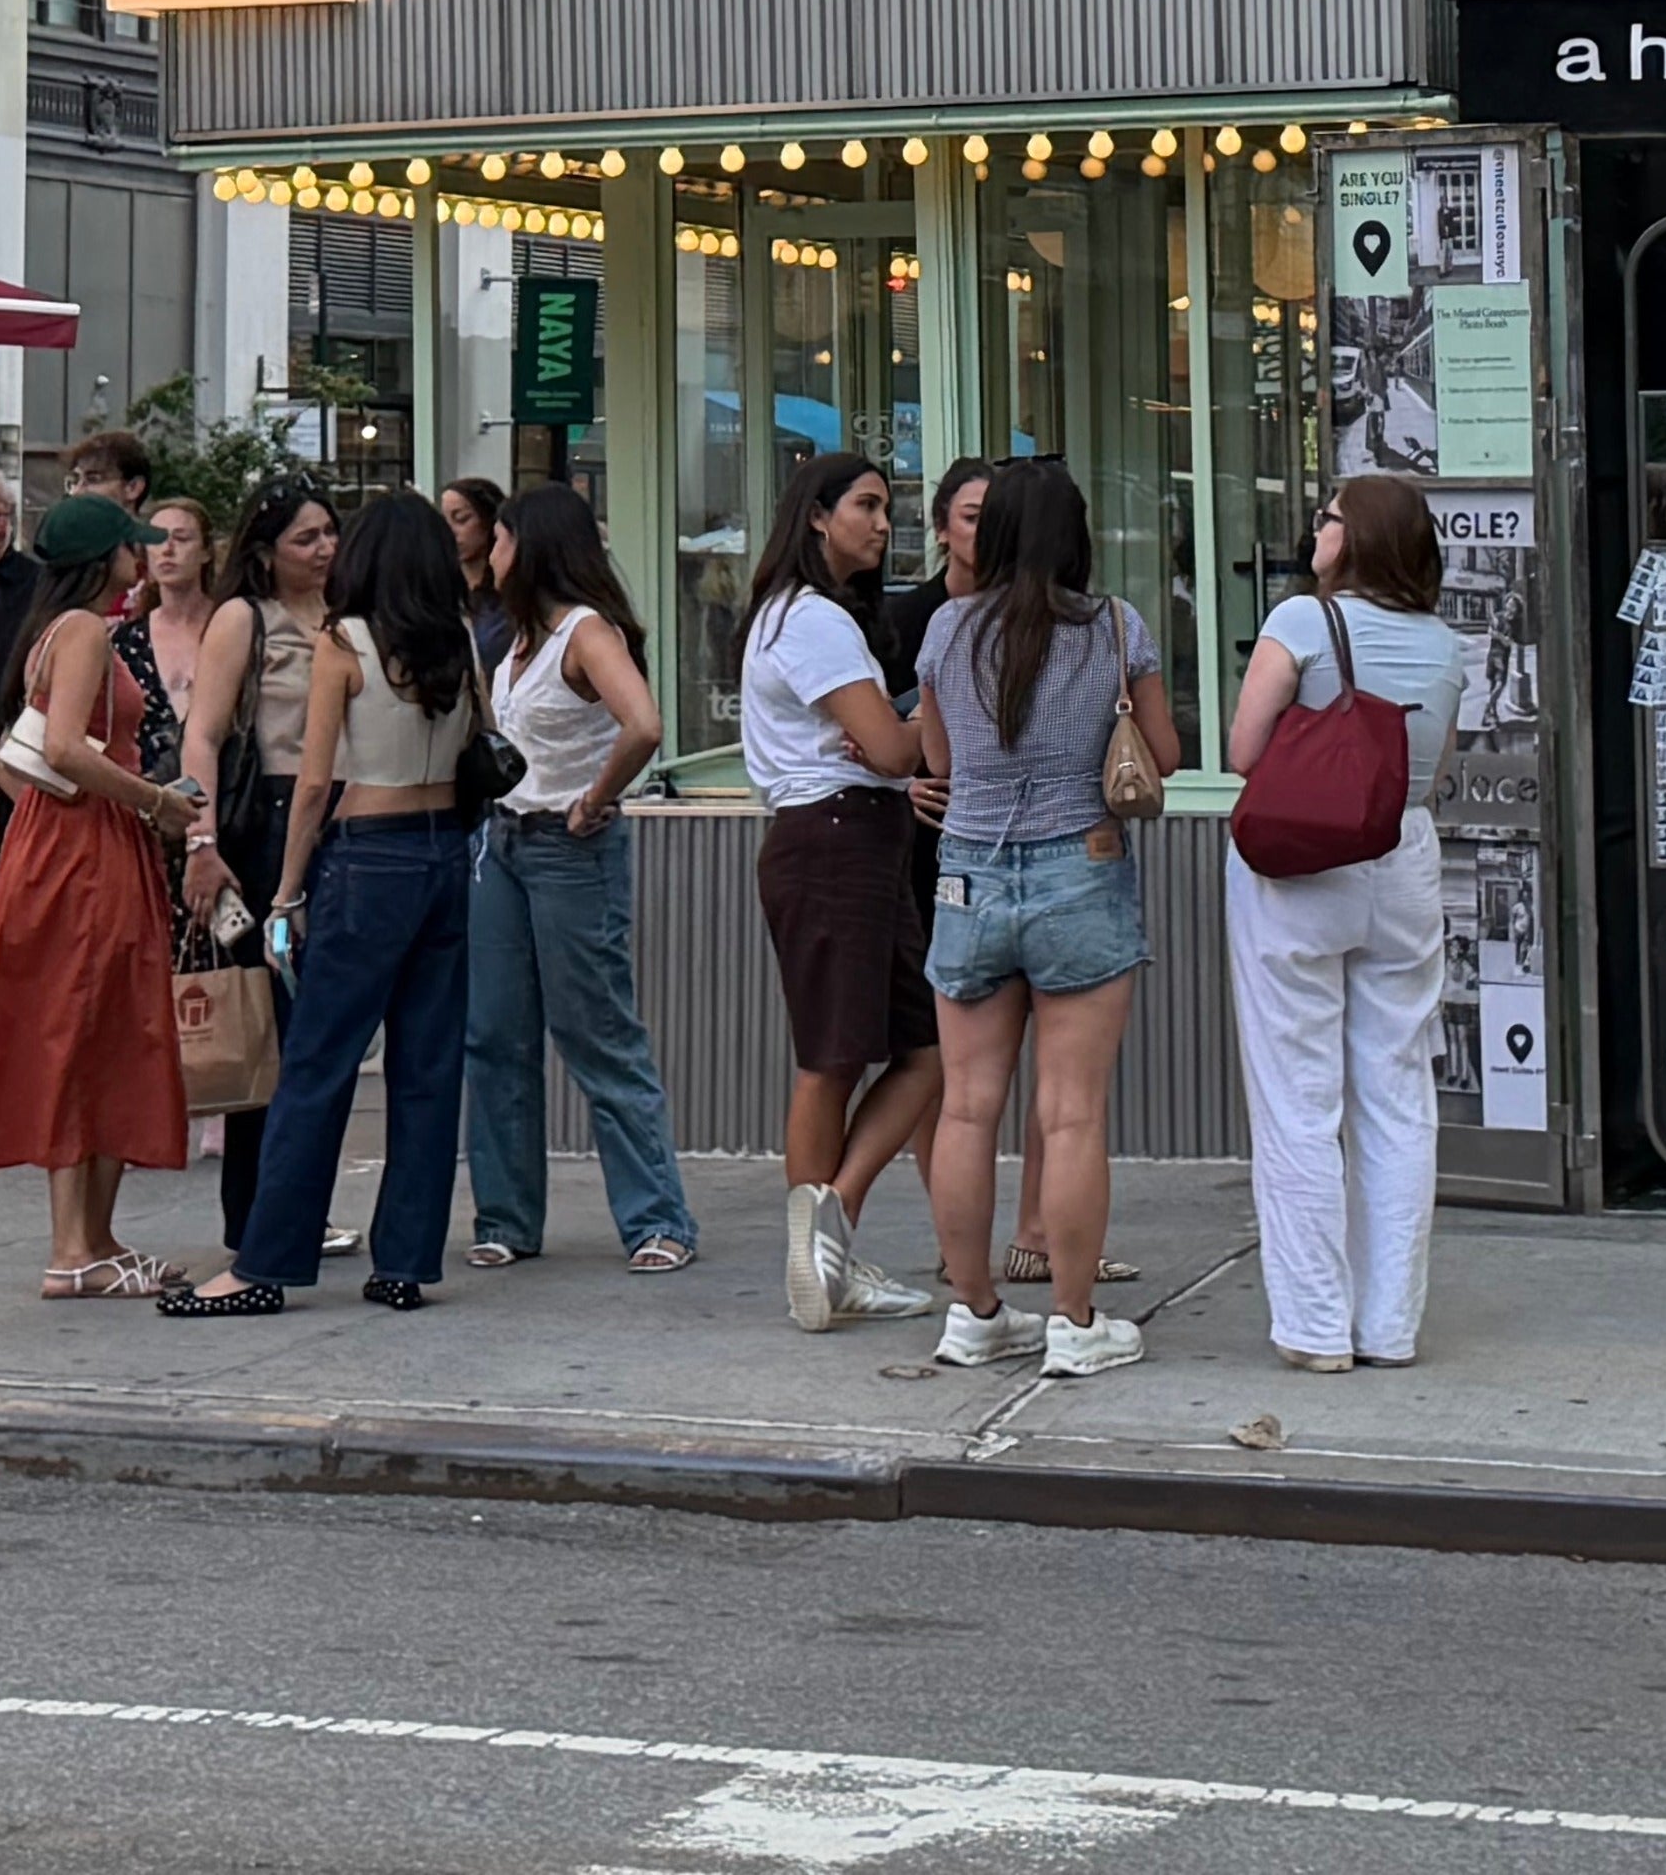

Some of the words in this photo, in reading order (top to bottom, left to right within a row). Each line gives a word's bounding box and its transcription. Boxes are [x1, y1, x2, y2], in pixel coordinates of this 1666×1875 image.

[1556, 37, 1605, 82] a
[1340, 172, 1367, 187] ARE
[1371, 170, 1404, 186] YOU
[537, 292, 576, 382] NAYA
[1433, 511, 1520, 542] NGLE?
